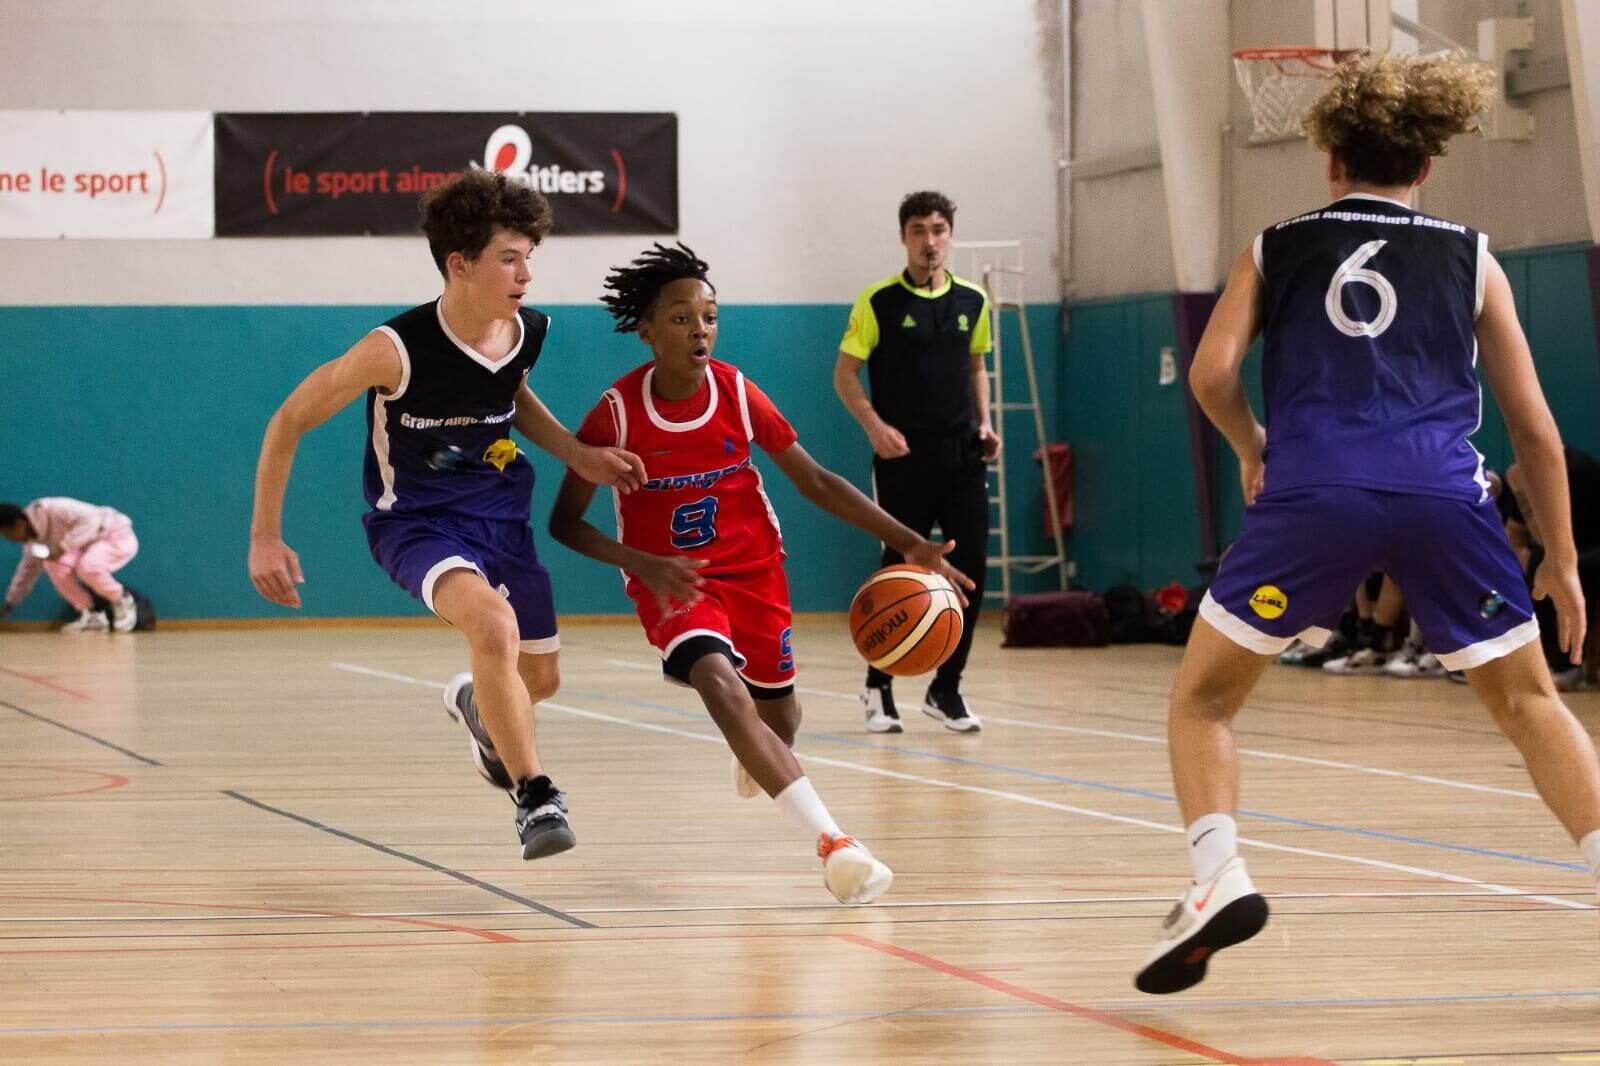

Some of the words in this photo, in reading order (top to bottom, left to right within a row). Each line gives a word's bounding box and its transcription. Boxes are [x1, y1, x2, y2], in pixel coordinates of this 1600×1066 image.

[41, 166, 66, 192] le
[316, 168, 390, 198] sport
[1325, 240, 1397, 338] 6
[670, 496, 718, 549] 9
